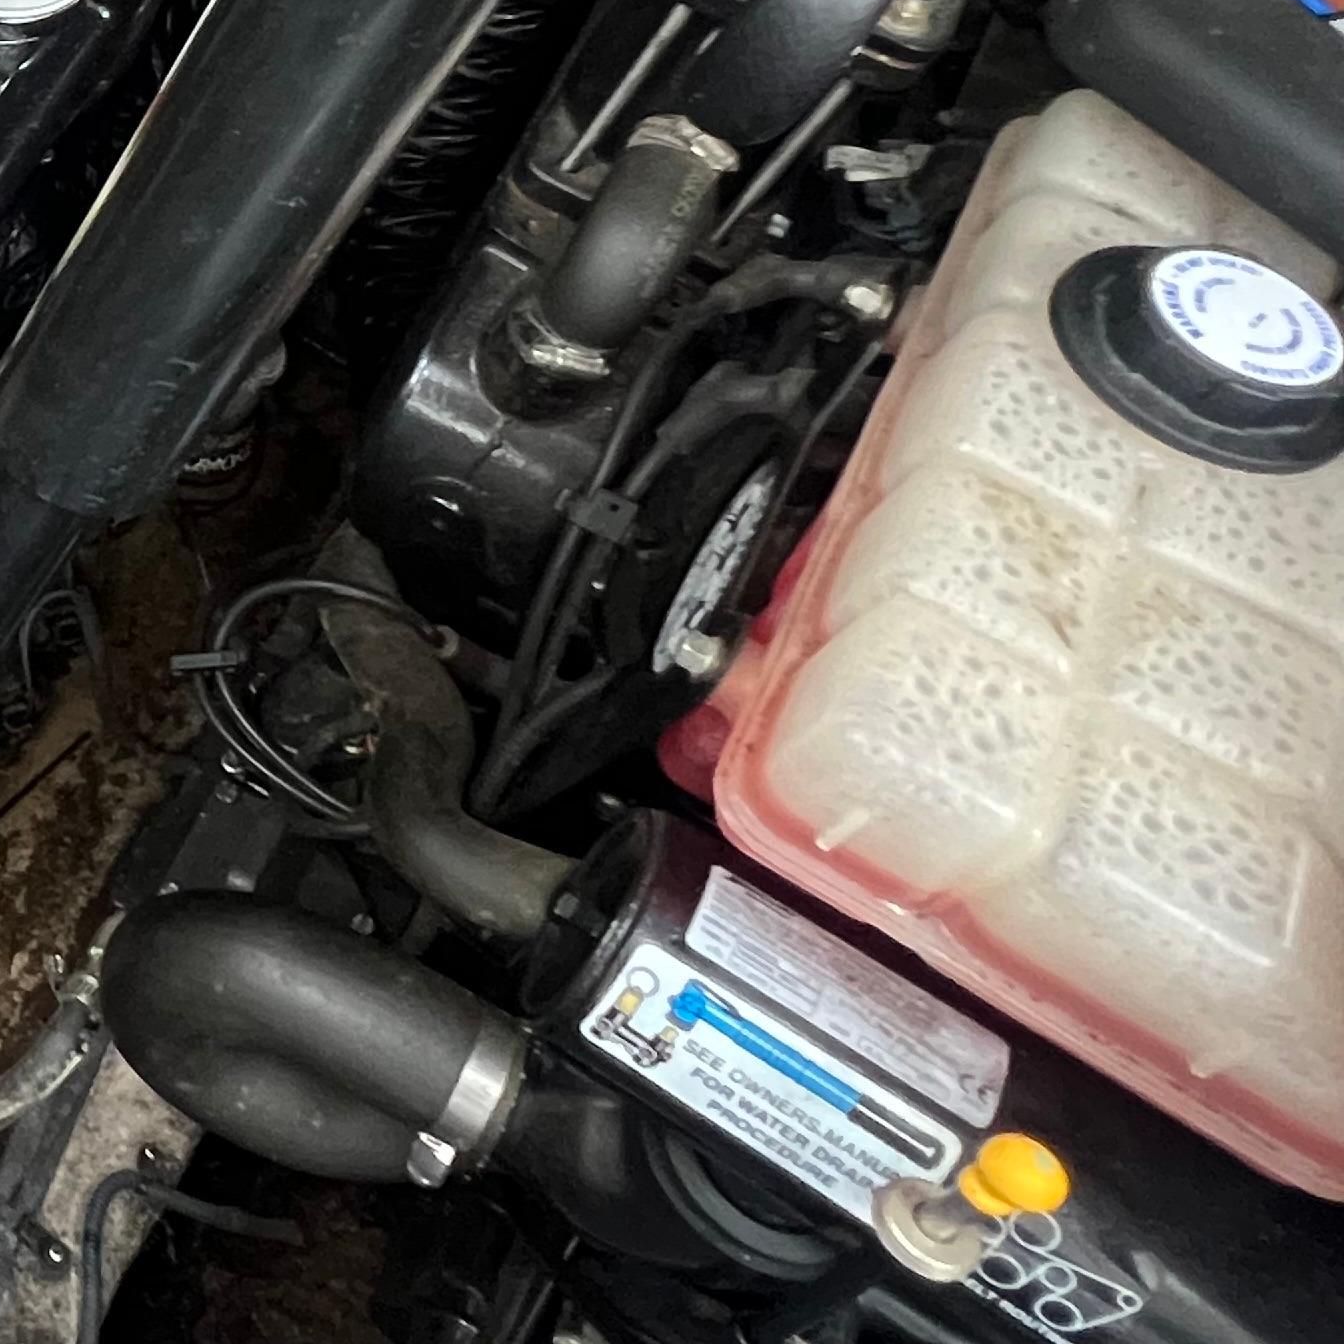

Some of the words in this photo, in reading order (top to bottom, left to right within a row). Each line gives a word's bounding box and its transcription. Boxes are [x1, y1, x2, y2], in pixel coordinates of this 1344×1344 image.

[683, 1038, 728, 1072] SEE
[690, 1067, 736, 1101] FOR
[738, 1095, 810, 1150] WATER
[706, 1099, 840, 1189] PROCEDURE
